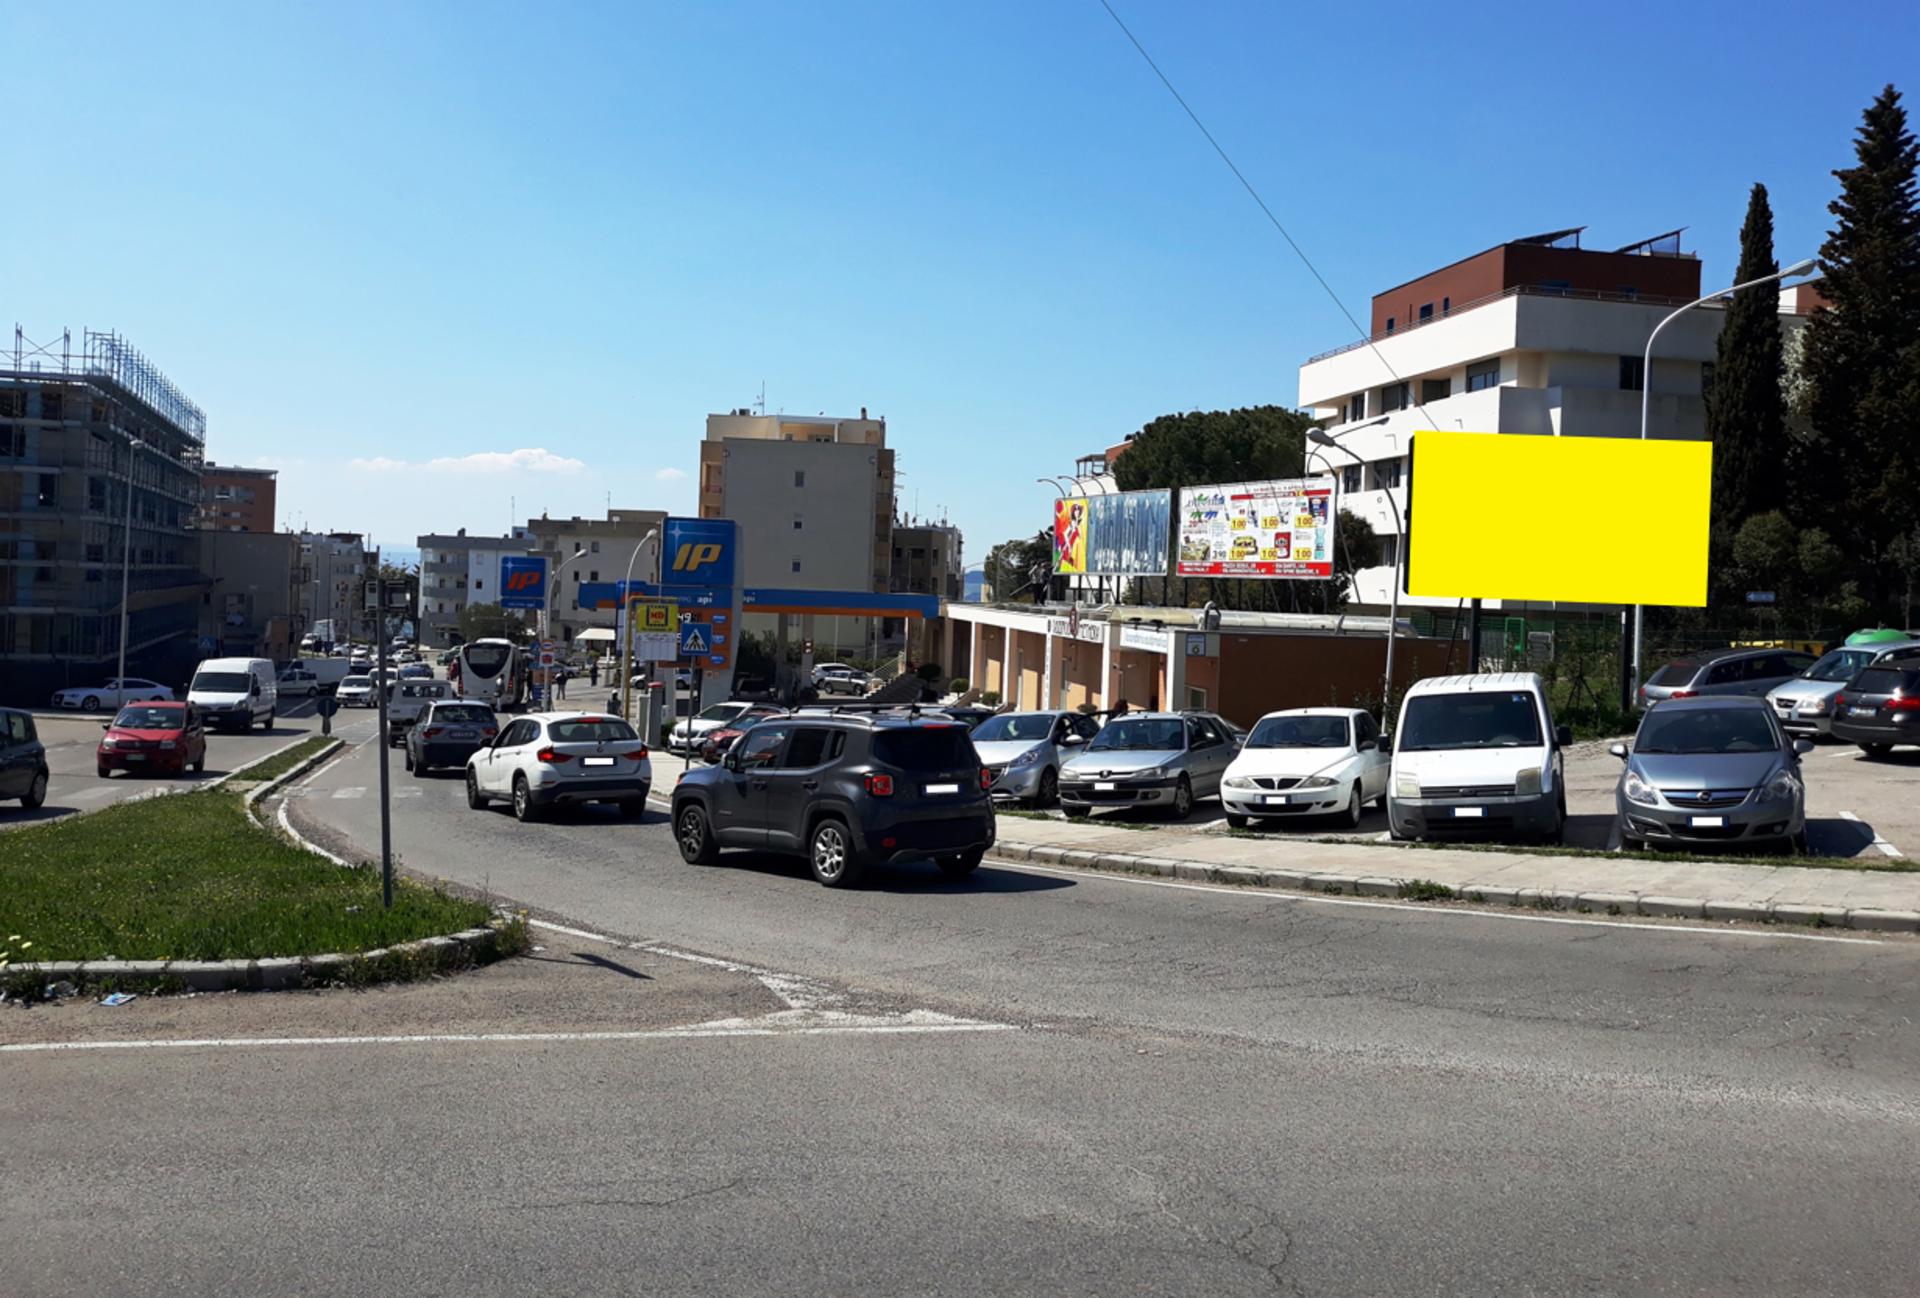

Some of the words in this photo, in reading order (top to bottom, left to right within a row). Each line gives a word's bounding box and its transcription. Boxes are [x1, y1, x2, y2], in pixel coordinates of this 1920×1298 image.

[672, 544, 721, 571] IP
[507, 571, 541, 592] IP
[697, 592, 713, 605] api
